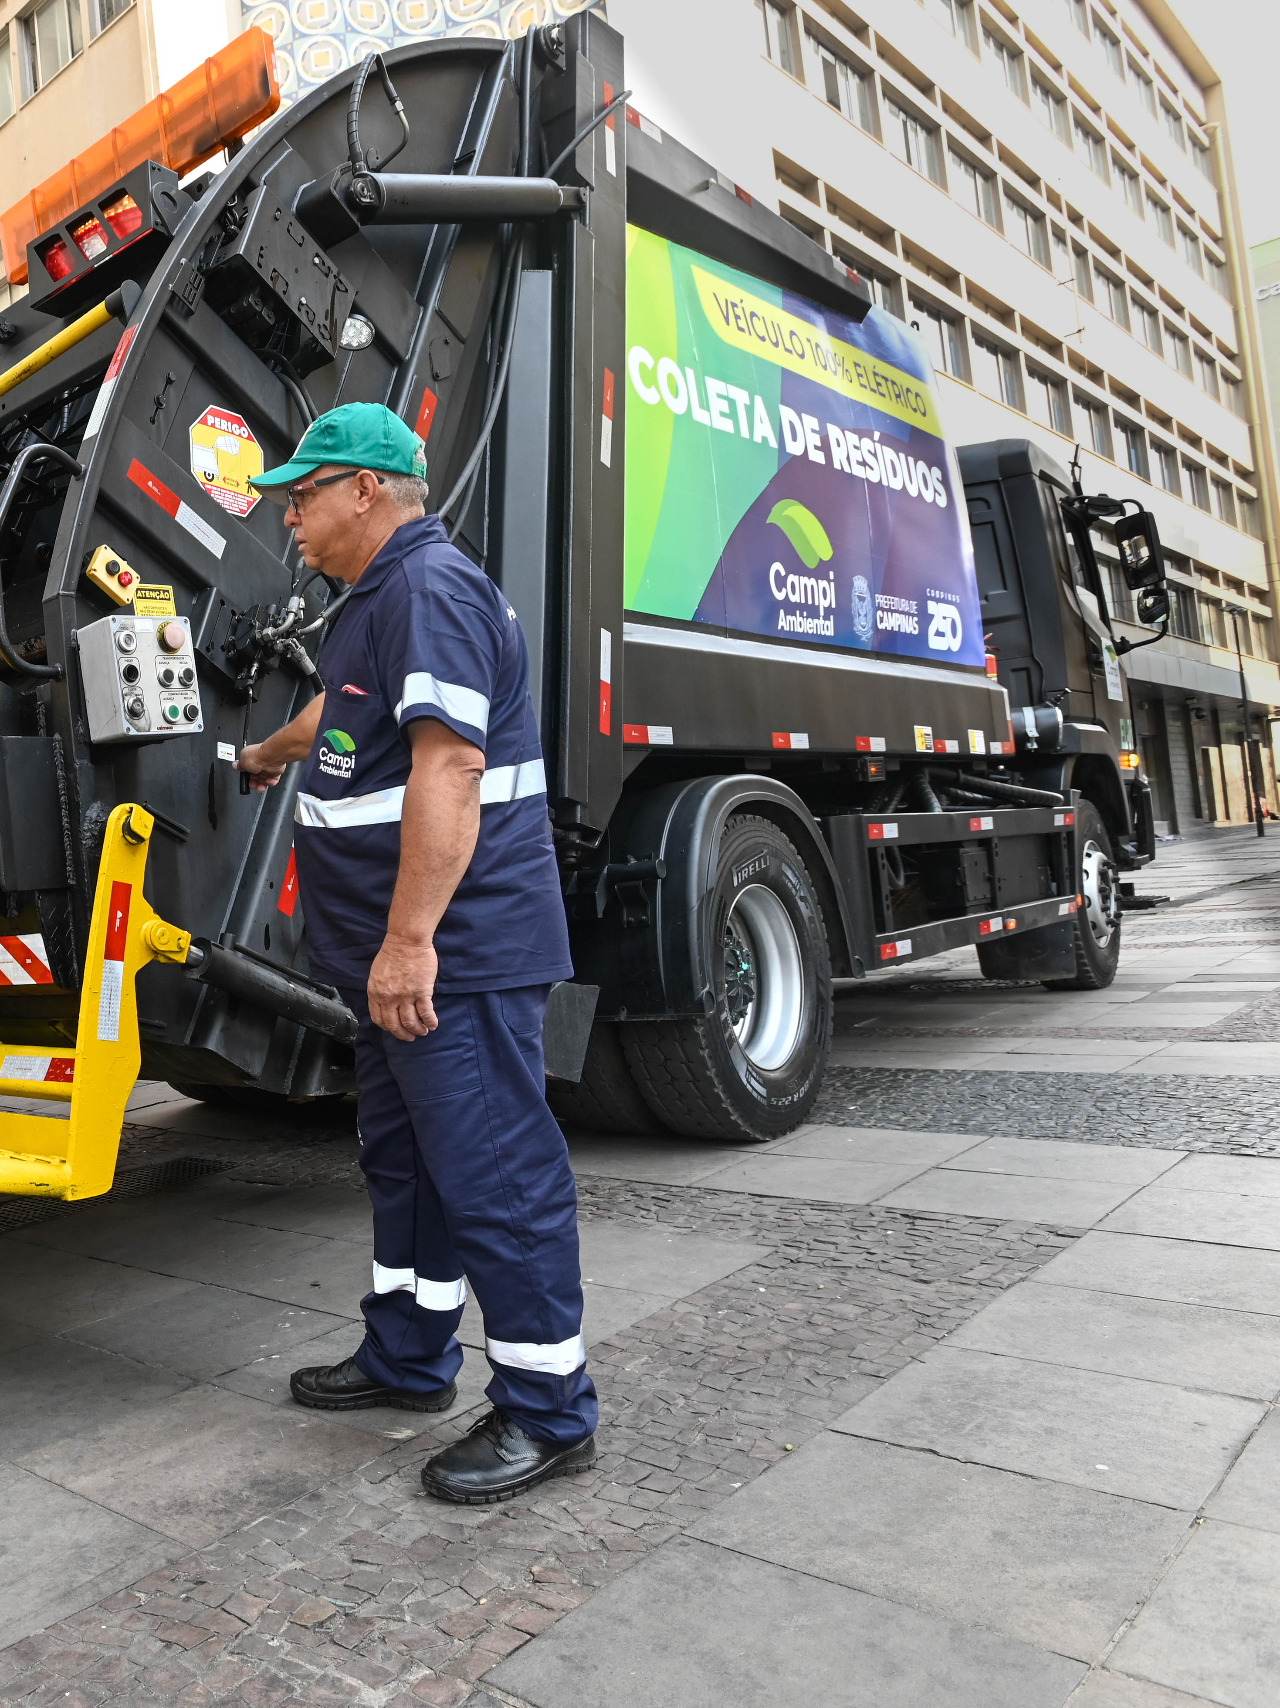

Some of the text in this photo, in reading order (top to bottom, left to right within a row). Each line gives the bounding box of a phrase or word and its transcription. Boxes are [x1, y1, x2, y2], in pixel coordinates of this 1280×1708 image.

[712, 292, 928, 418] VEÍCULO 100% ELÉTRICO
[207, 414, 249, 438] PERIGO
[628, 345, 948, 508] COLETA DE RESÍDUOS
[136, 589, 170, 600] ATENÇÃO
[769, 561, 836, 617] Campi
[875, 593, 918, 614] PREFEITURA DE
[777, 609, 835, 637] Ambiental
[876, 609, 919, 635] CAMPINAS
[927, 600, 963, 652] 250
[319, 746, 356, 771] Campi
[319, 762, 352, 778] Ambiental
[731, 848, 770, 888] PIRELLI
